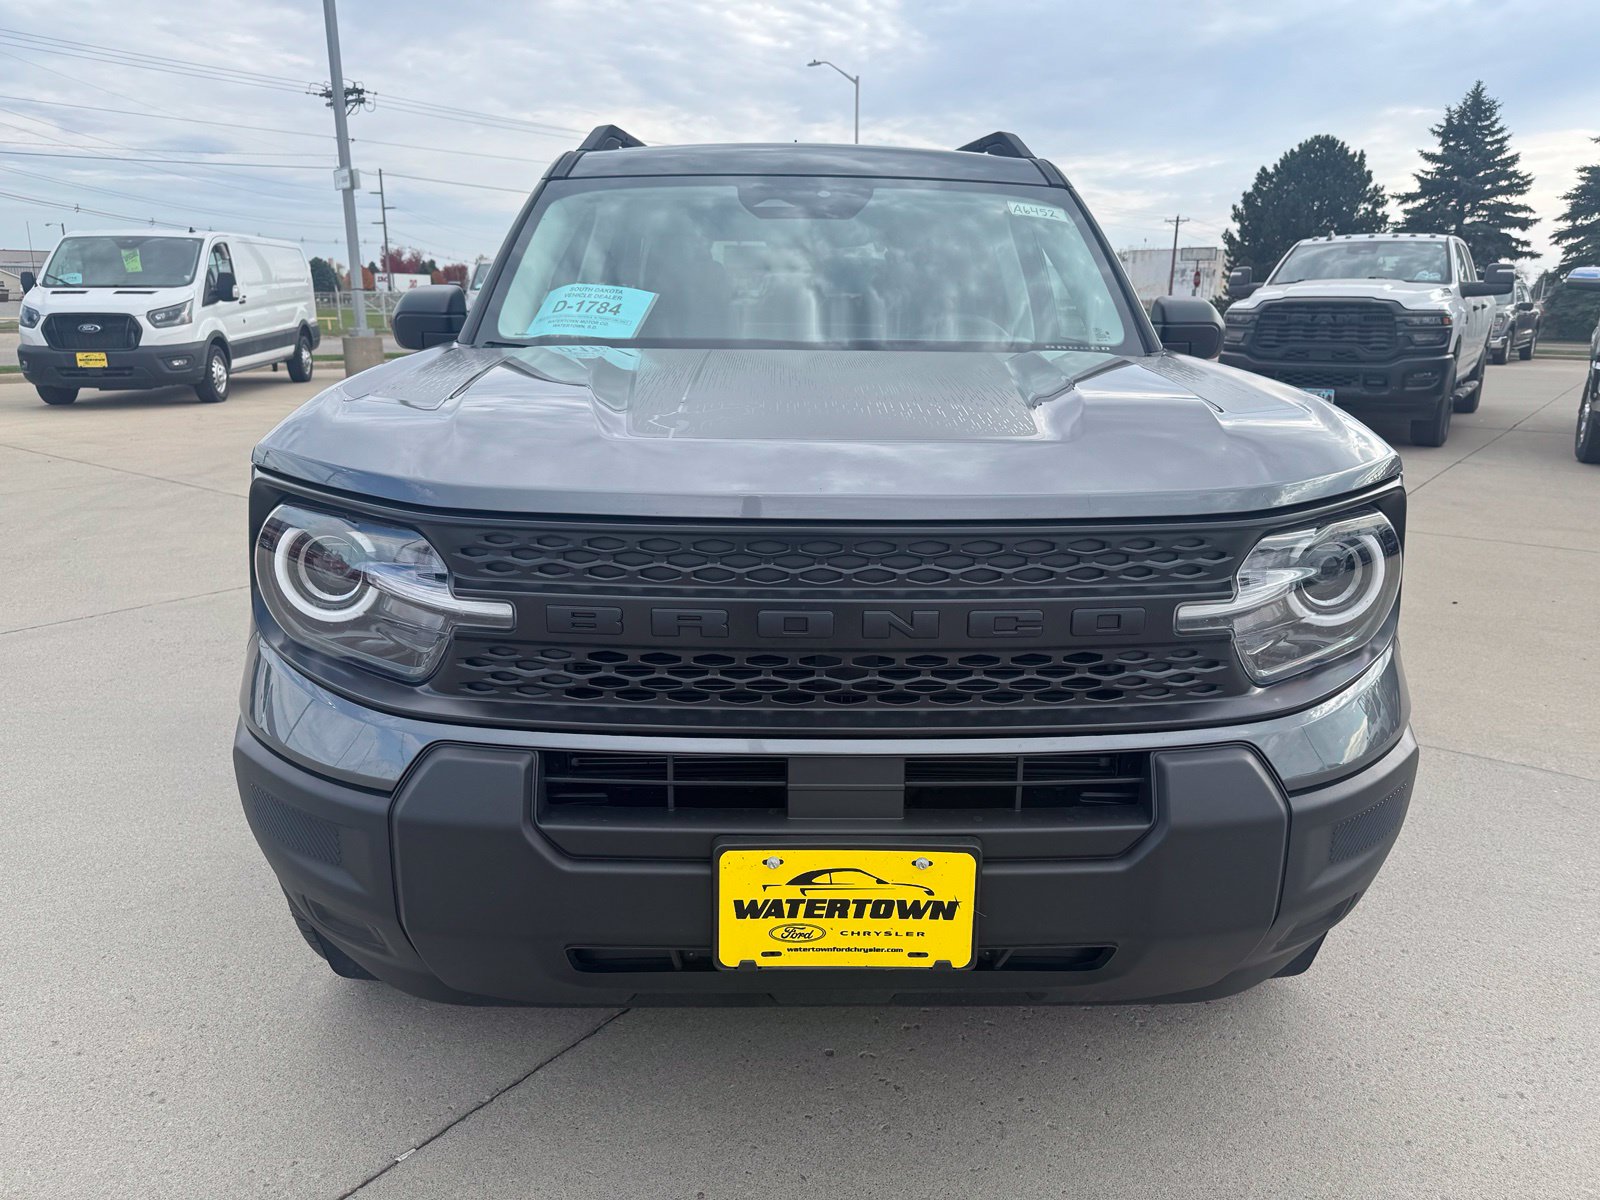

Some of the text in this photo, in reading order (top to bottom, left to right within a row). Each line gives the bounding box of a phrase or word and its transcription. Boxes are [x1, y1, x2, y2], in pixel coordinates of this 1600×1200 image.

[1013, 204, 1059, 217] A6452
[552, 300, 622, 315] D-1784
[546, 604, 1146, 639] BRONCO
[733, 899, 957, 920] WATERTOWN
[780, 926, 814, 940] Ford
